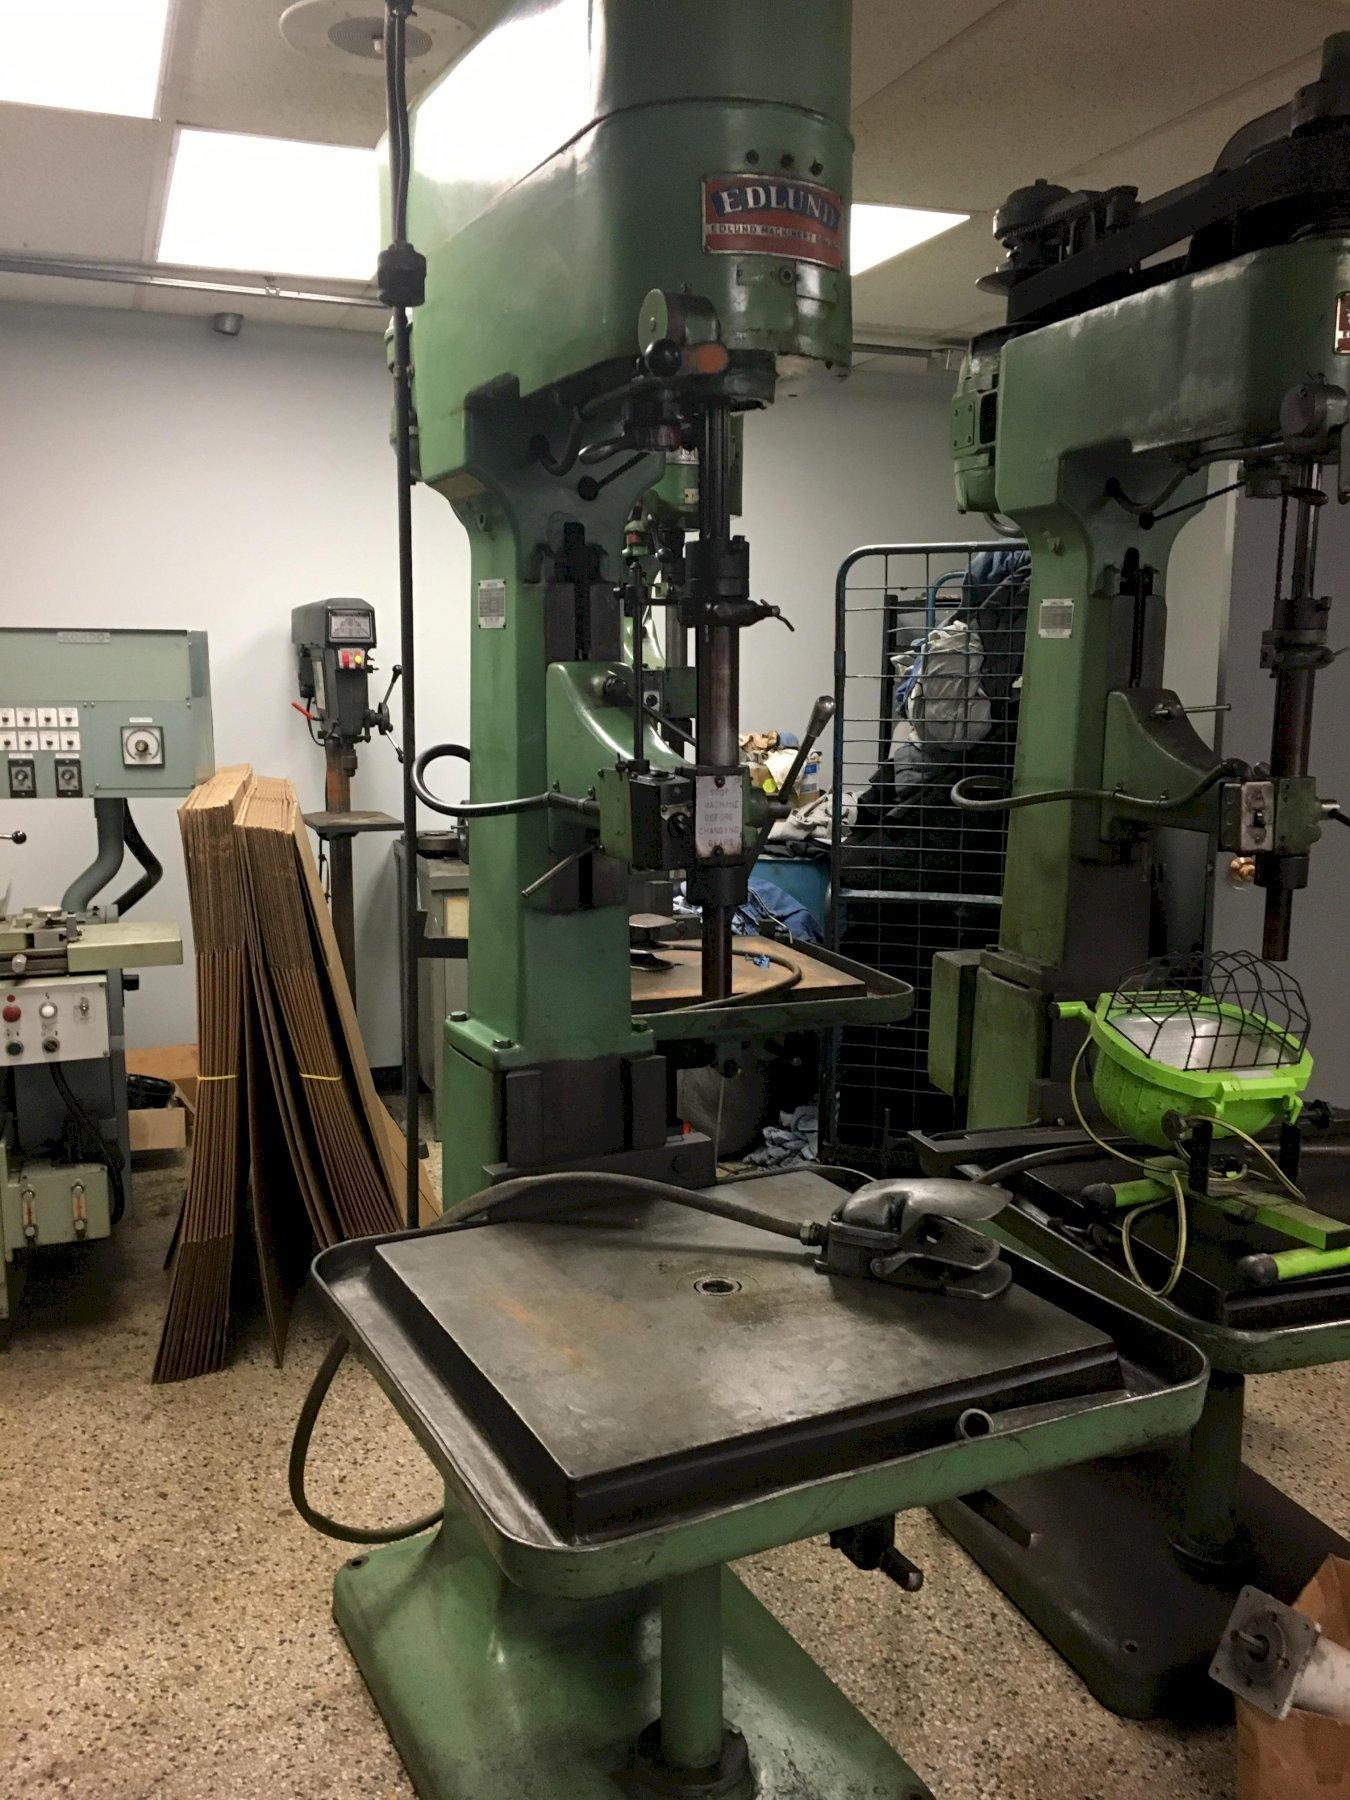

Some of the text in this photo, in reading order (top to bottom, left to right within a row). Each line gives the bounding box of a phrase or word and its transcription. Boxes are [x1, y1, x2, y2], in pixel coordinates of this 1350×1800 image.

[720, 185, 838, 227] EDLUND
[711, 224, 757, 234] EDLUND
[704, 800, 740, 809] MACHINE
[704, 813, 734, 822] BEFORE
